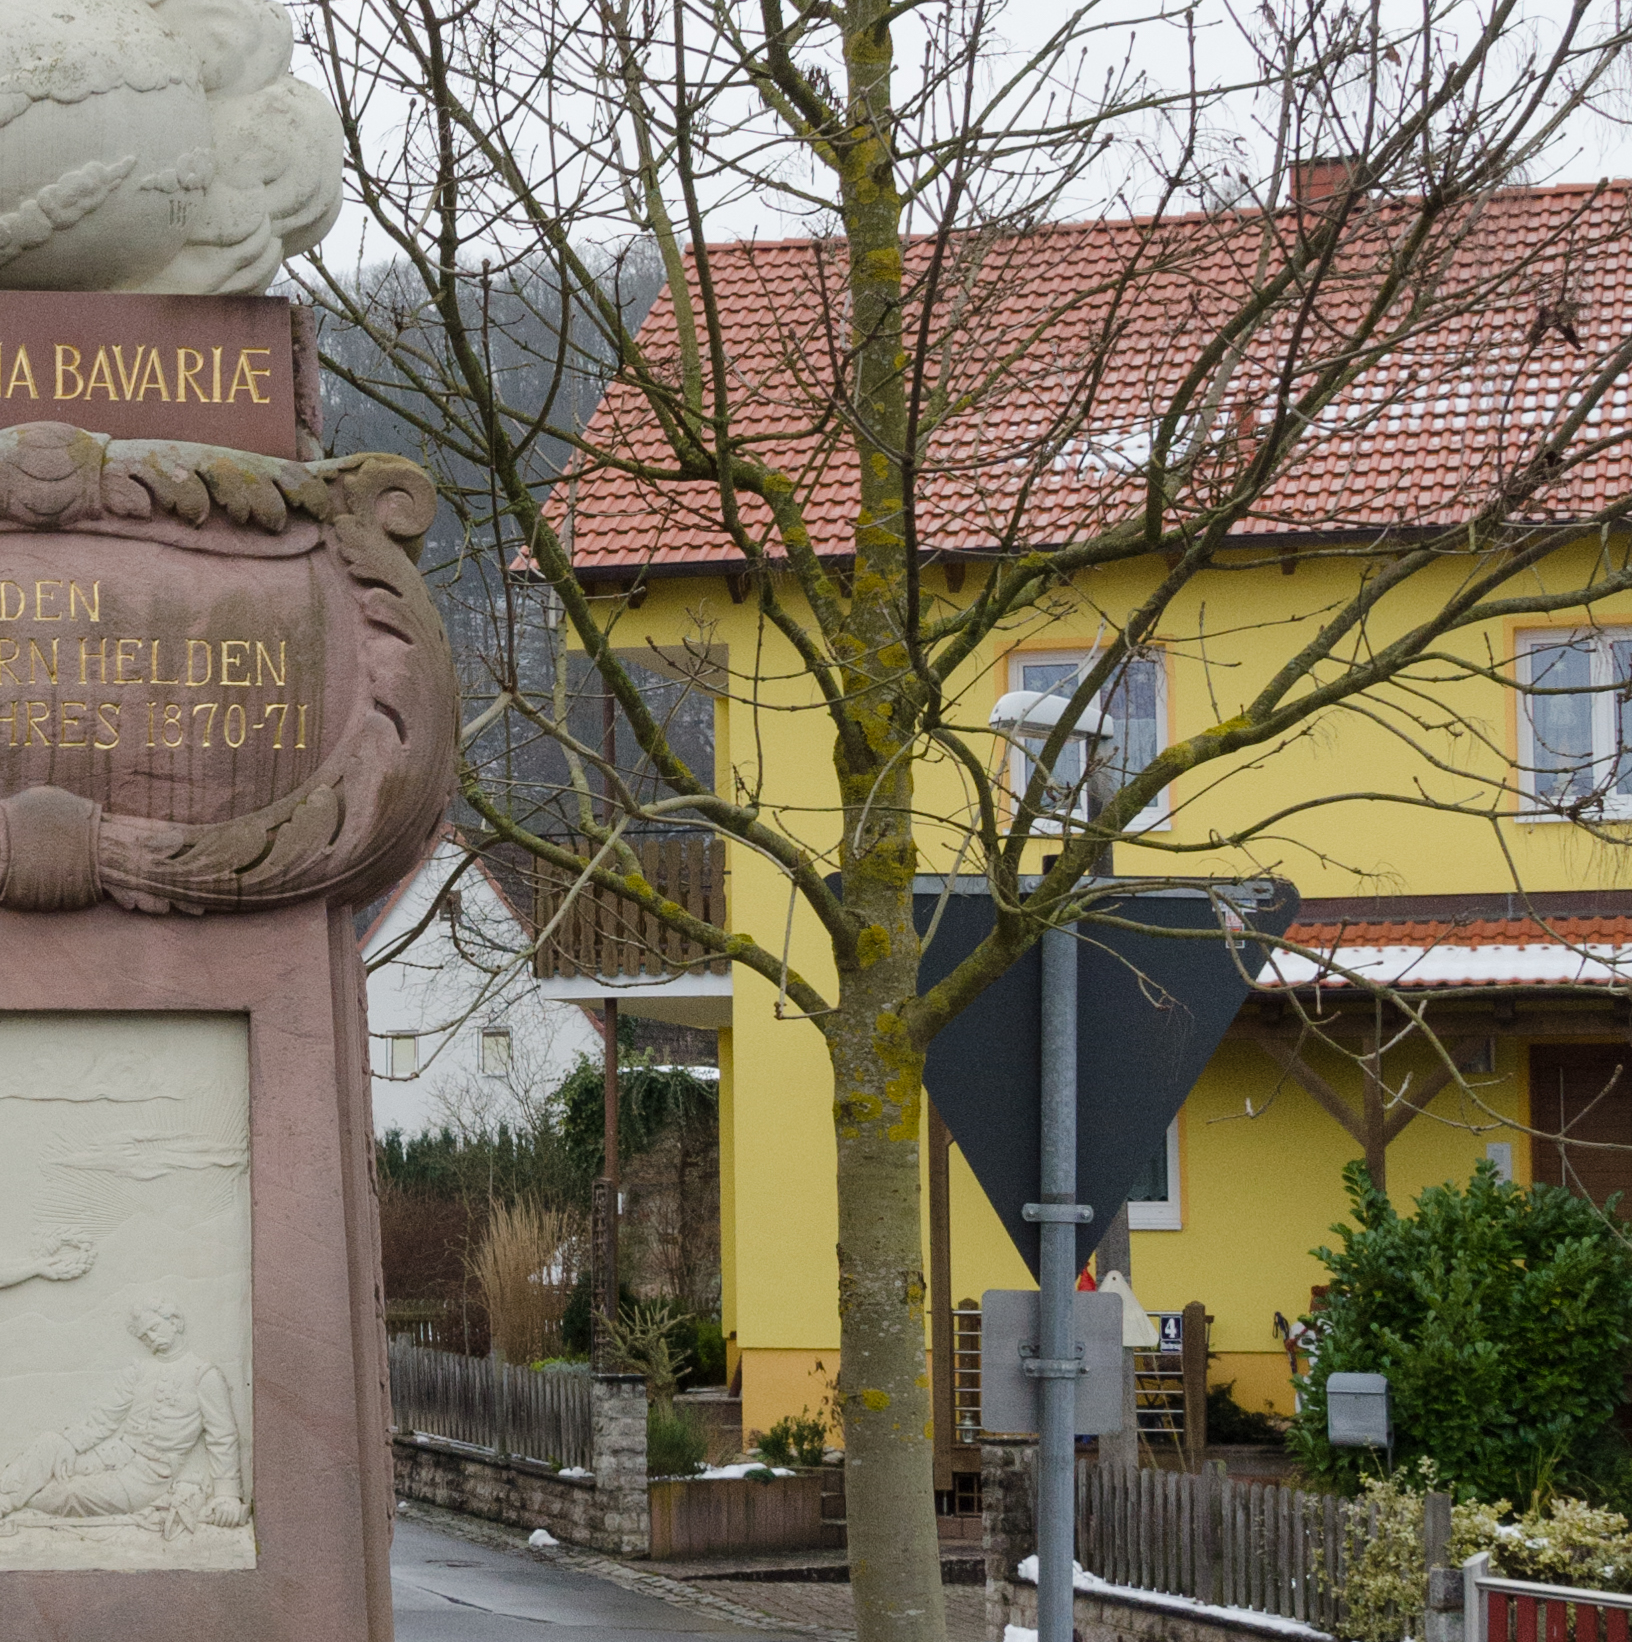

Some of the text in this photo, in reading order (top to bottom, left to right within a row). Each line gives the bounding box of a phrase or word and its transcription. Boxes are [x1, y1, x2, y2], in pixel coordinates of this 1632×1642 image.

[53, 343, 271, 403] BAVARIÆ
[78, 638, 286, 686] HELDEN
[145, 702, 308, 749] 1870-71
[1164, 1318, 1177, 1339] 4
